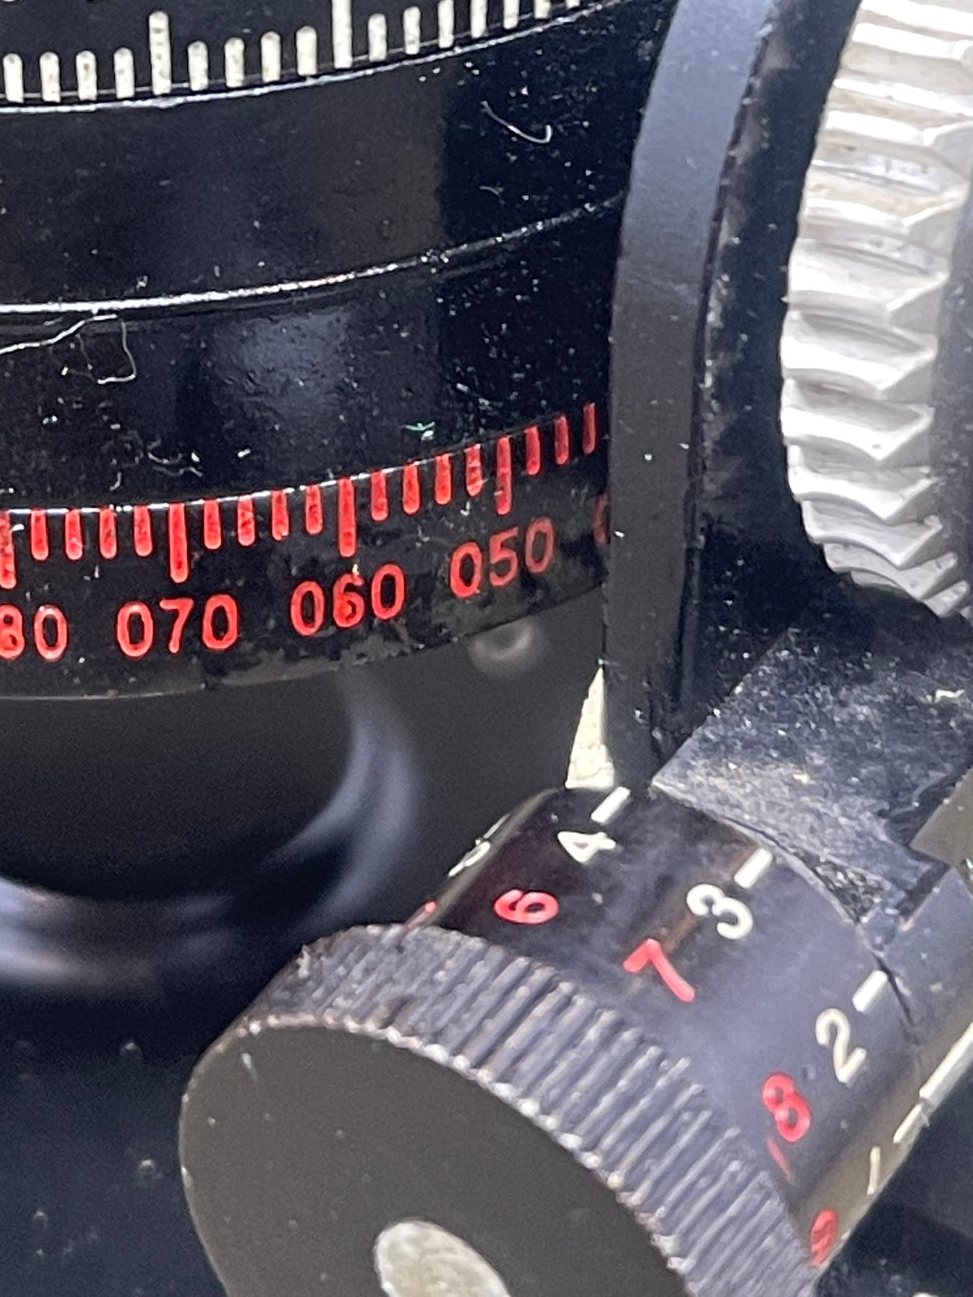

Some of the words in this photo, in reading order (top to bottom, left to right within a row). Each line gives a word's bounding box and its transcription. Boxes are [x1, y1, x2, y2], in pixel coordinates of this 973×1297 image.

[115, 593, 240, 660] 070
[290, 563, 408, 638] 060
[449, 516, 557, 599] 050
[556, 829, 617, 863] 4
[493, 888, 560, 926] 6
[685, 883, 754, 940] 3
[623, 938, 695, 1003] 7
[814, 1007, 867, 1084] 2
[761, 1071, 812, 1142] 8
